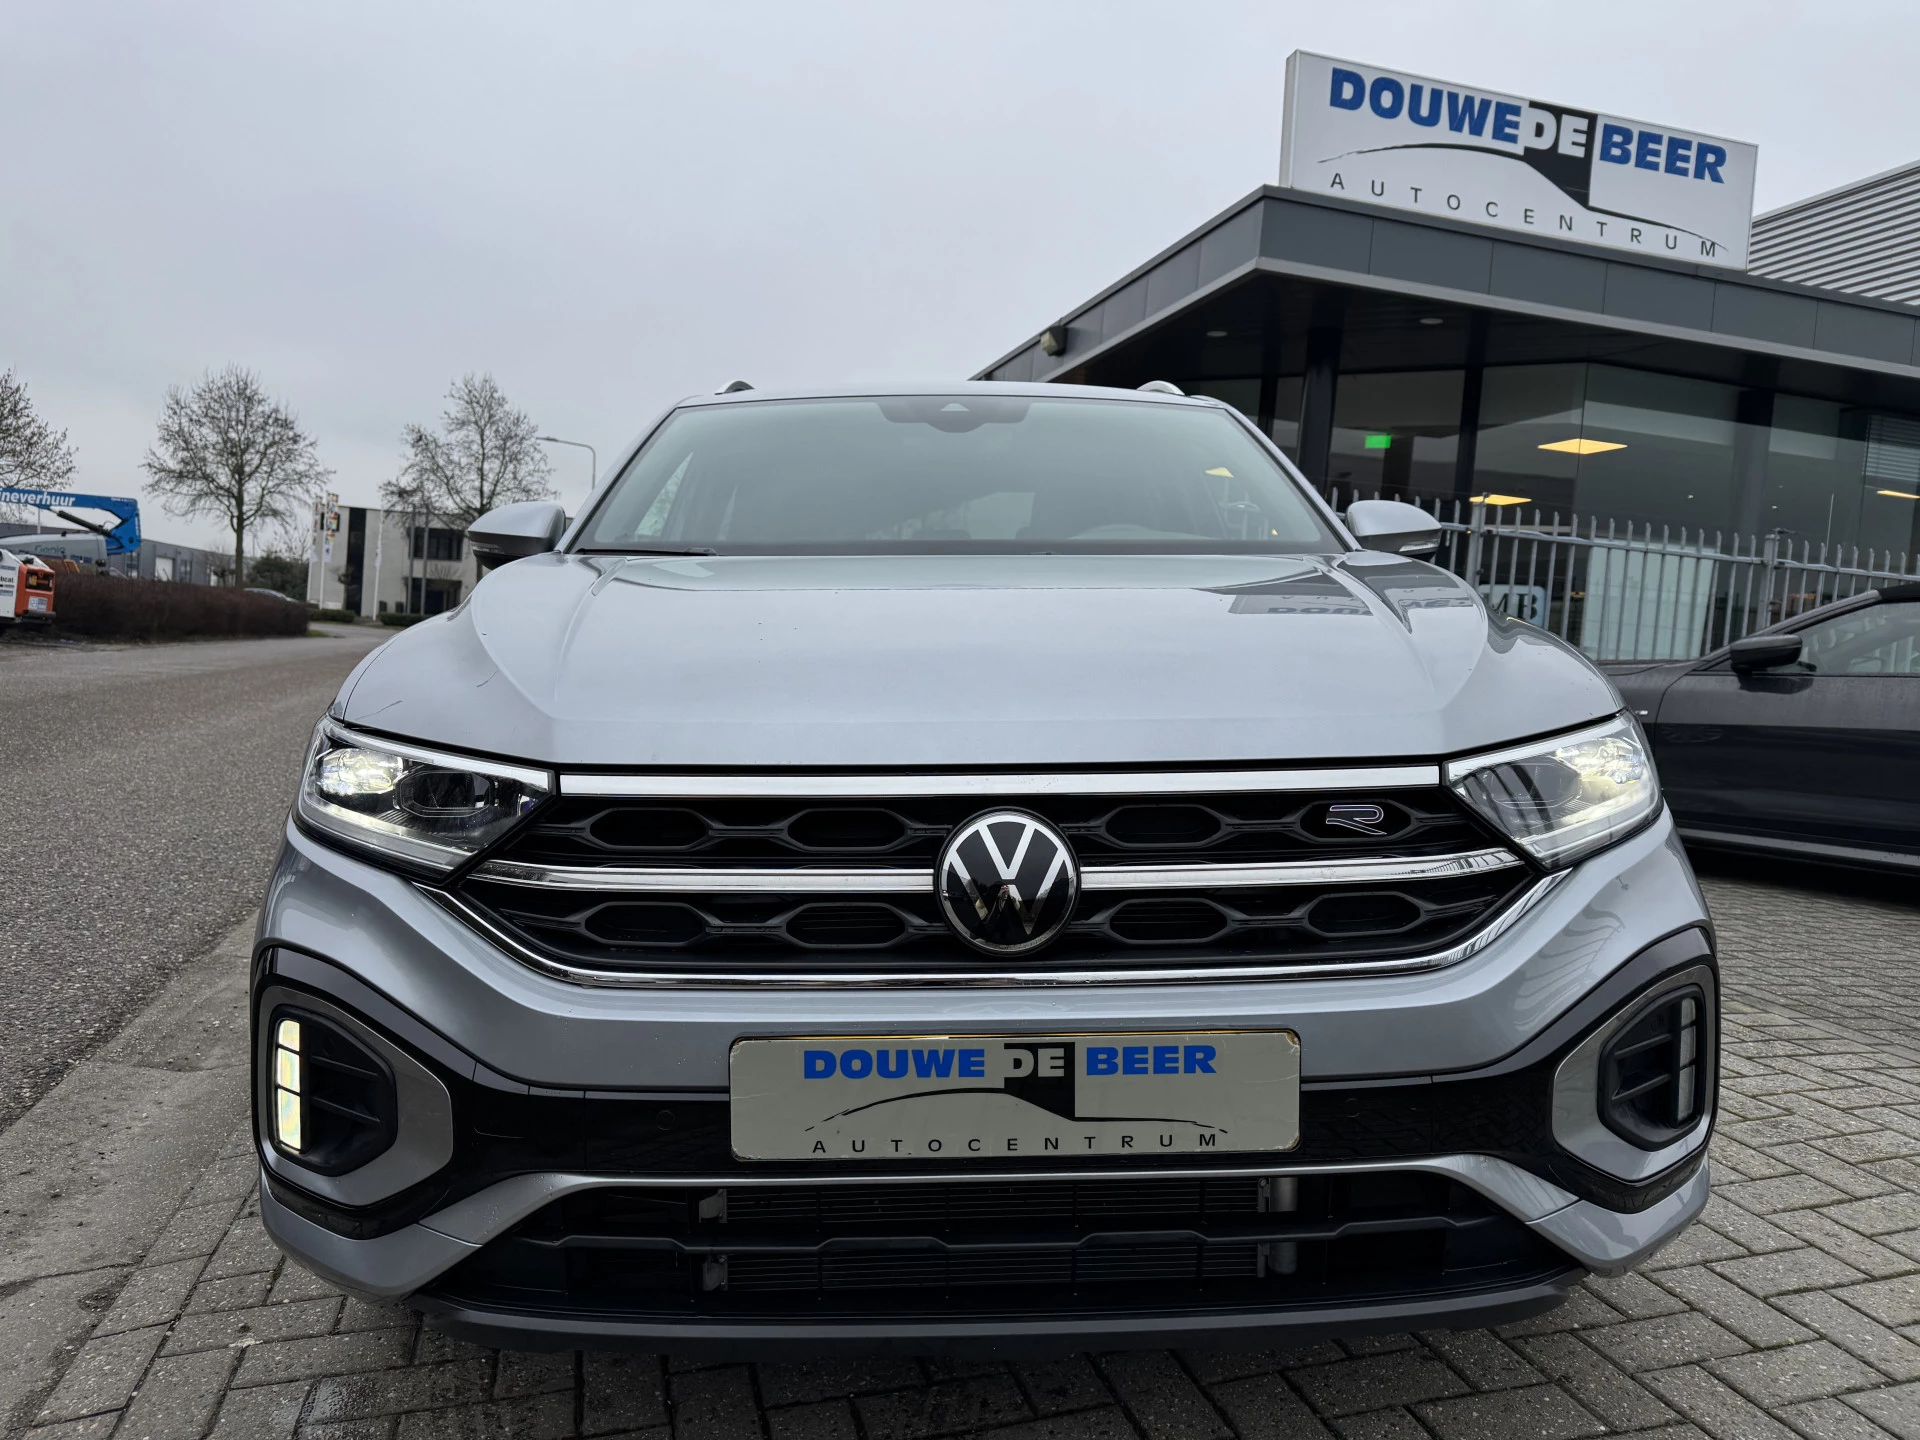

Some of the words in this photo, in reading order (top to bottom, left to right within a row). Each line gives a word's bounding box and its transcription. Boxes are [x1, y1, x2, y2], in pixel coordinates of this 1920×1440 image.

[1329, 66, 1523, 145] DOUWE
[1524, 107, 1590, 159] DE
[1599, 122, 1728, 185] BEER
[1330, 172, 1717, 258] AUTOCENTRUM
[0, 575, 14, 583] bcat
[803, 1048, 986, 1080] DOUWE
[1002, 1048, 1065, 1079] DE
[1086, 1044, 1217, 1077] BEER
[812, 1133, 1217, 1154] AUTOCENTRUM
